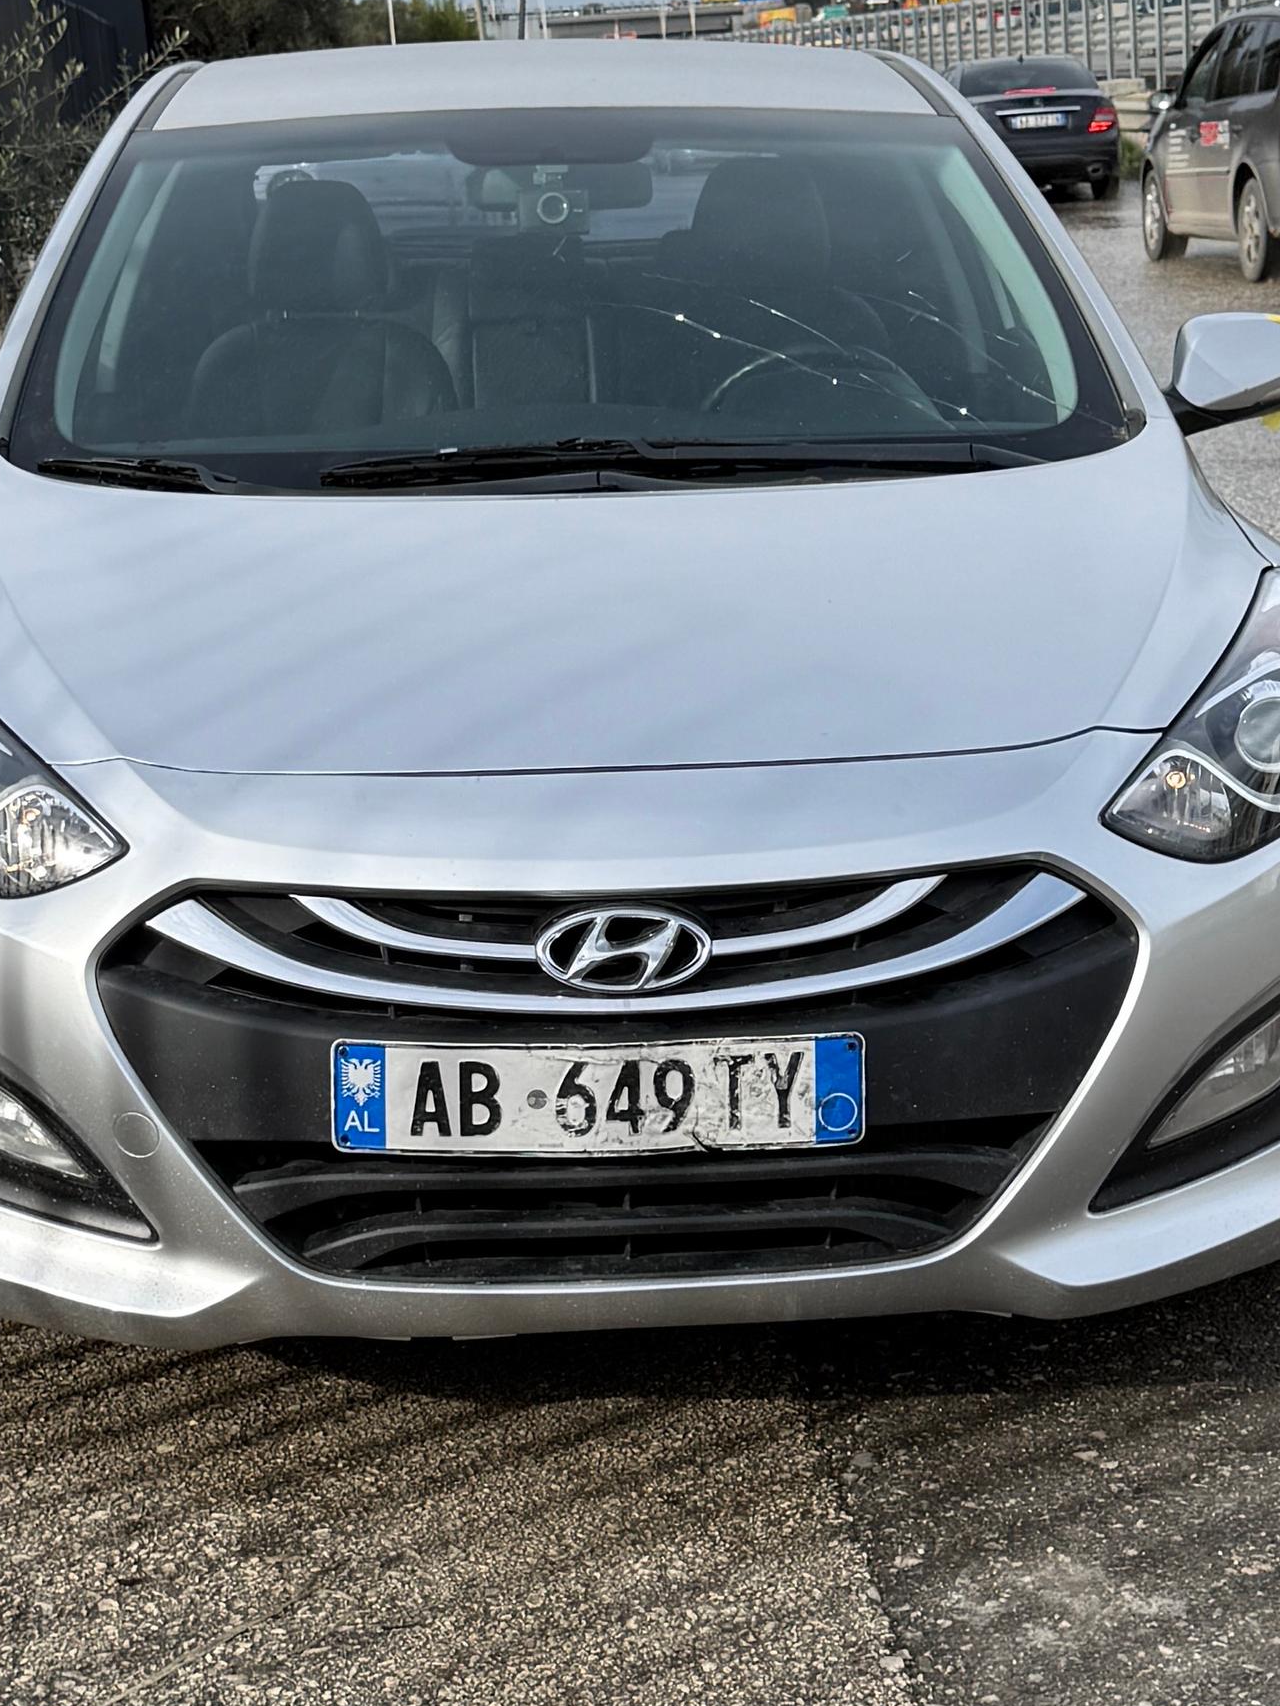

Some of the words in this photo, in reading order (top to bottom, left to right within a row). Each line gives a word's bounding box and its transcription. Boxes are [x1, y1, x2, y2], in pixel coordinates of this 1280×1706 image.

[410, 1061, 502, 1136] AB
[556, 1059, 695, 1137] 649
[713, 1051, 804, 1131] TY
[344, 1110, 380, 1133] AL
